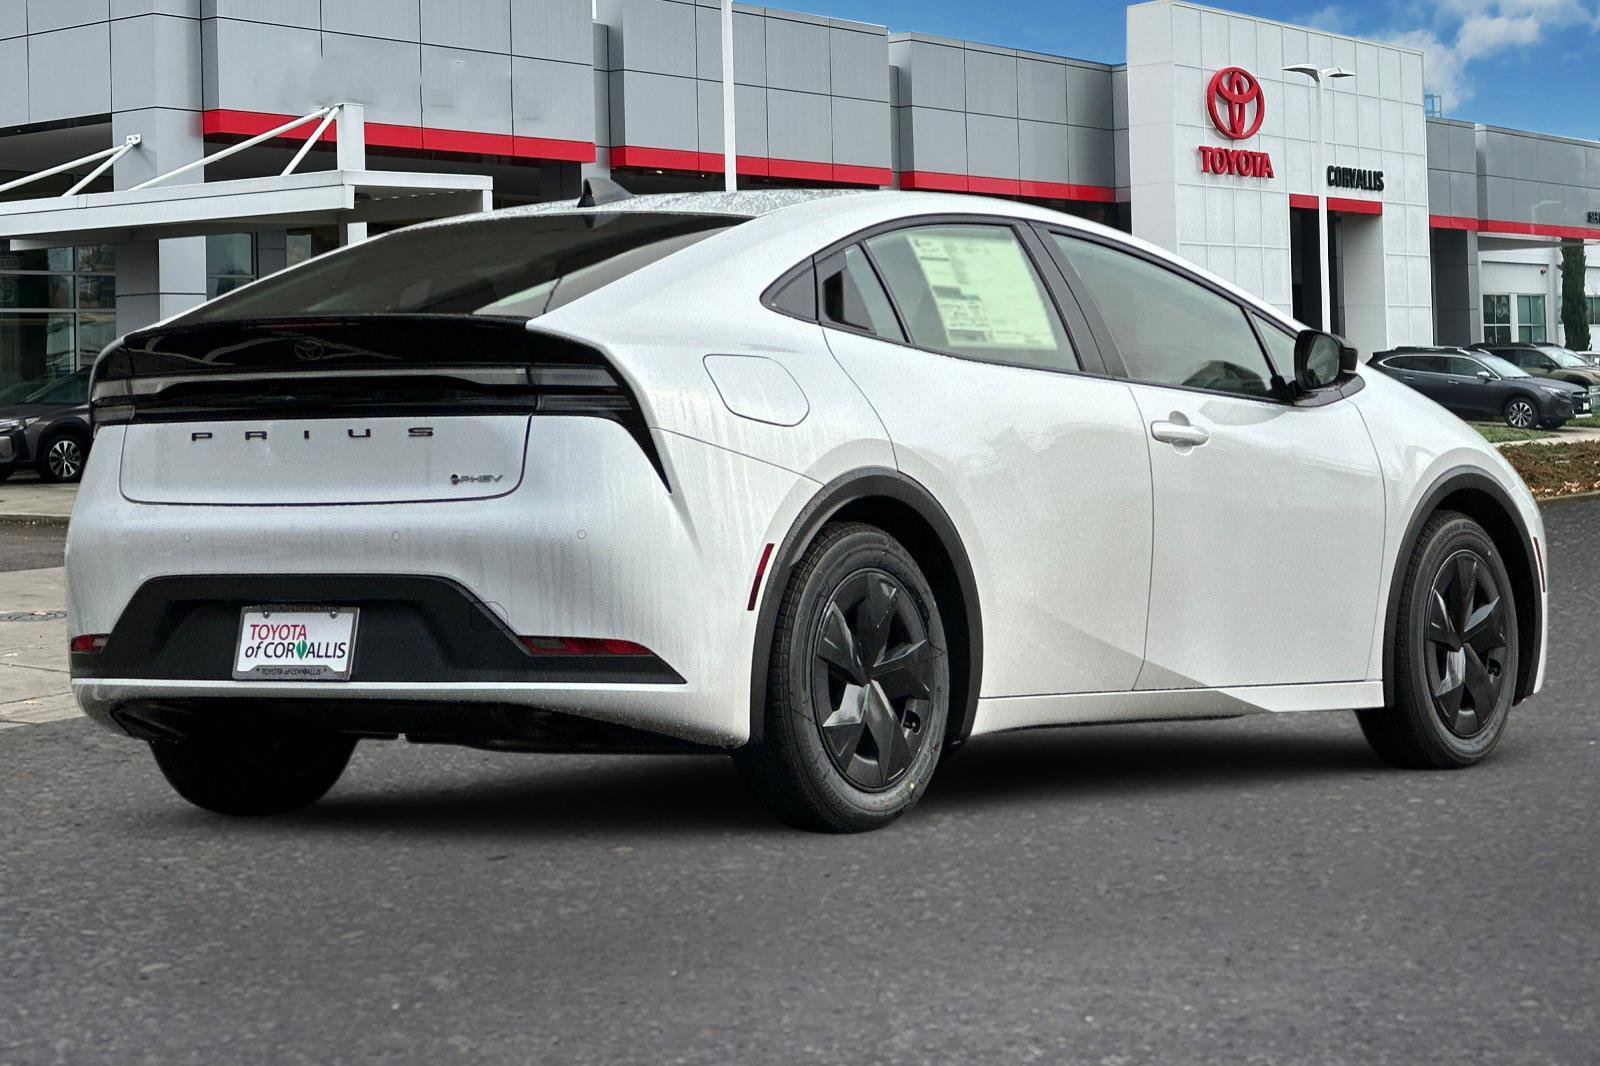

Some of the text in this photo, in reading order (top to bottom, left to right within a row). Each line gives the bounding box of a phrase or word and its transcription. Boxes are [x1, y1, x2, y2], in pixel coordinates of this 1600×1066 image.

[1199, 146, 1274, 178] TOYOTA
[1327, 165, 1384, 191] CORVALLIS
[191, 427, 433, 441] PRIUS
[250, 624, 307, 640] TOYOTA
[245, 640, 346, 660] of CORVALLIS
[261, 668, 283, 676] TOYOTA
